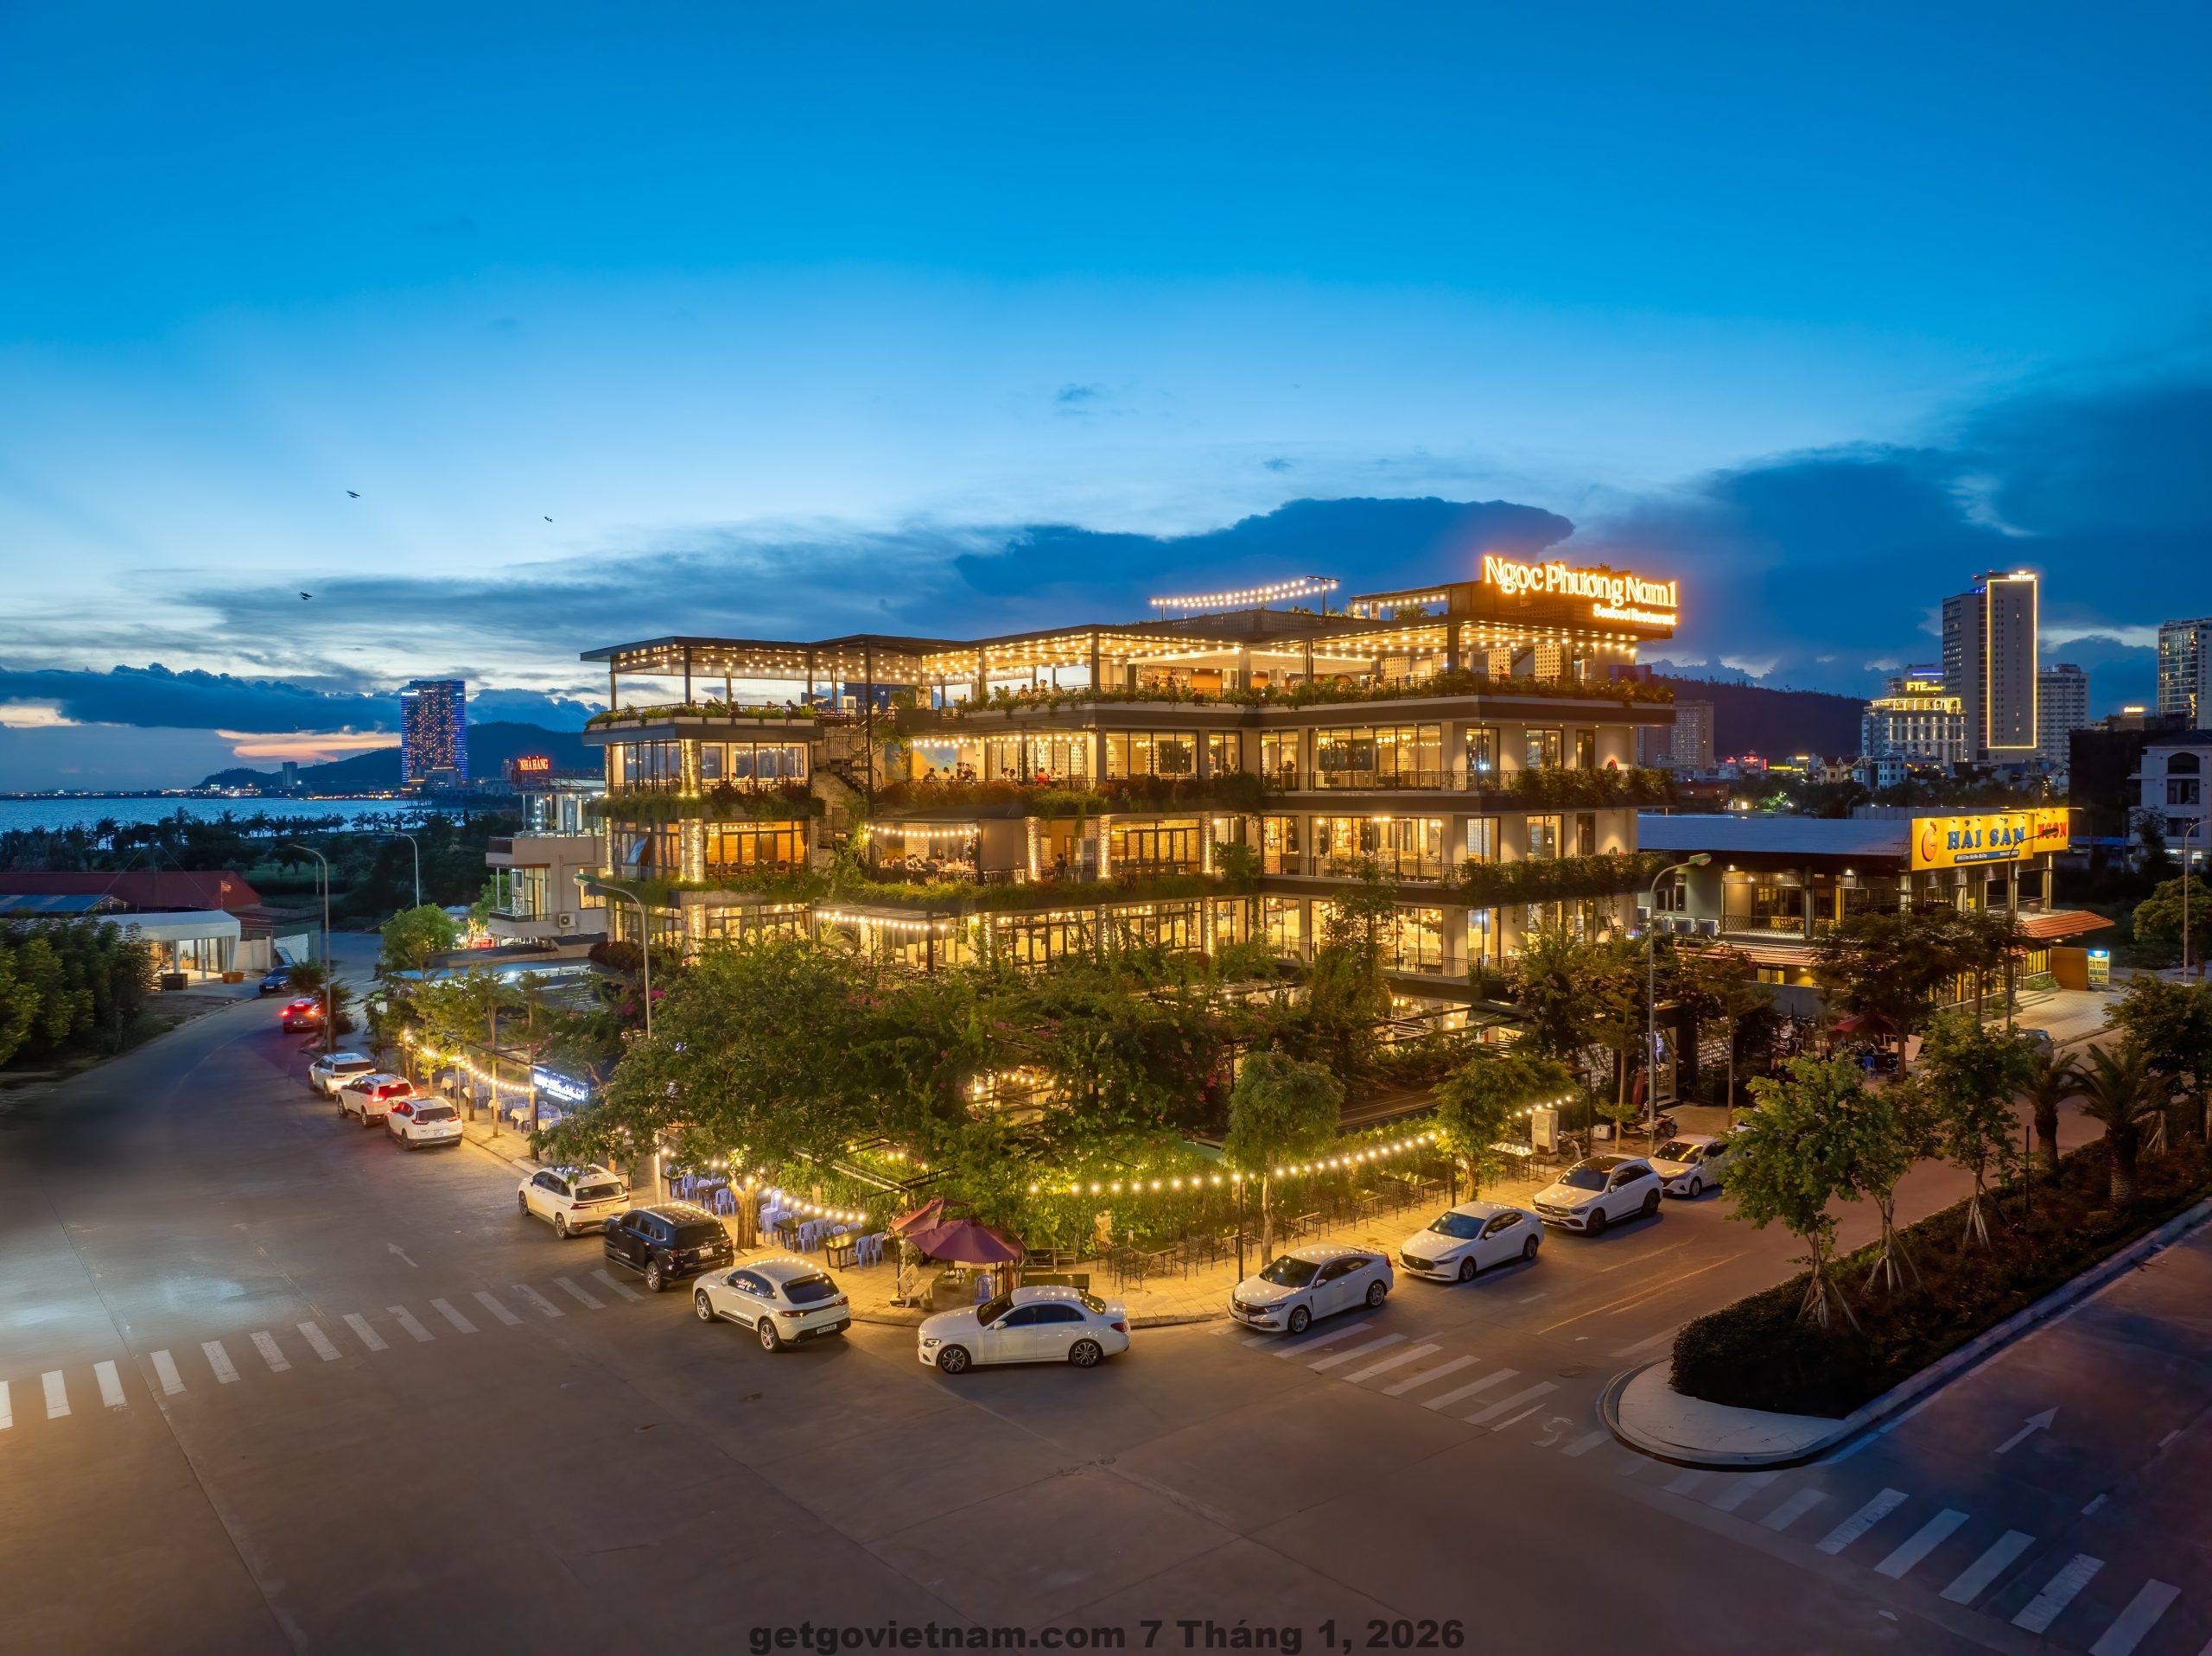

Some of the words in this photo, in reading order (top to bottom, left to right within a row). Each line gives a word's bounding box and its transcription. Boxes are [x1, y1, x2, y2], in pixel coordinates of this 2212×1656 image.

[1484, 555, 1543, 594] Ngọc
[1546, 564, 1624, 606] Phương
[1907, 682, 1928, 691] FTE
[520, 756, 532, 771] NHÀ
[1947, 820, 1982, 850] HẢI
[1989, 818, 2026, 847] SẢN
